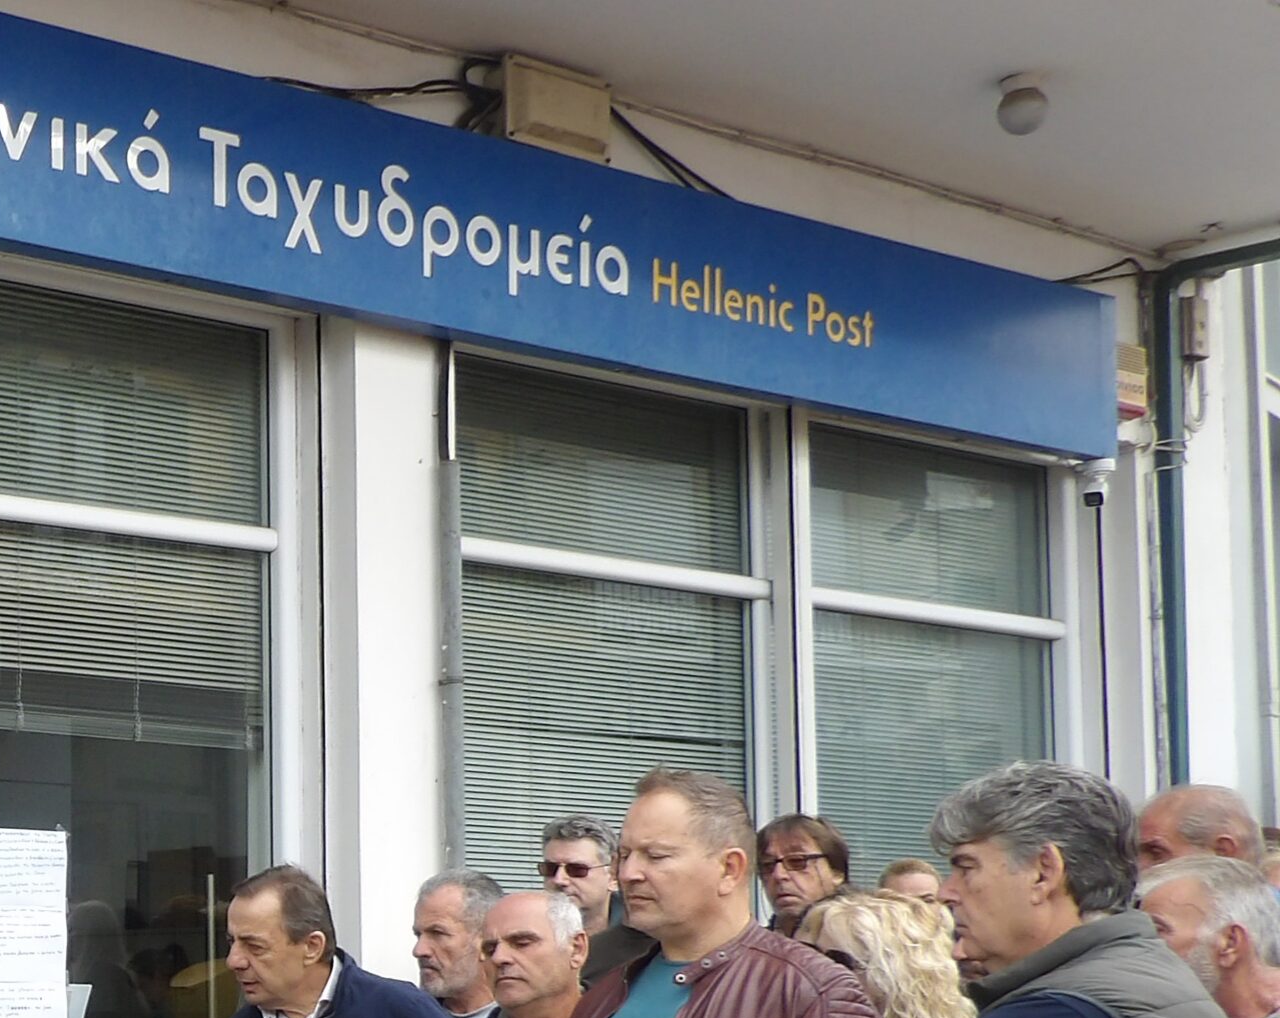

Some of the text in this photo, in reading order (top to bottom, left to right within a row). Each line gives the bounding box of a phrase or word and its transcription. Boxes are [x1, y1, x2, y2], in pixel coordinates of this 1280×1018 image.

[198, 126, 629, 297] Ταχυδρομεία
[651, 257, 875, 348] Hellenic Post
